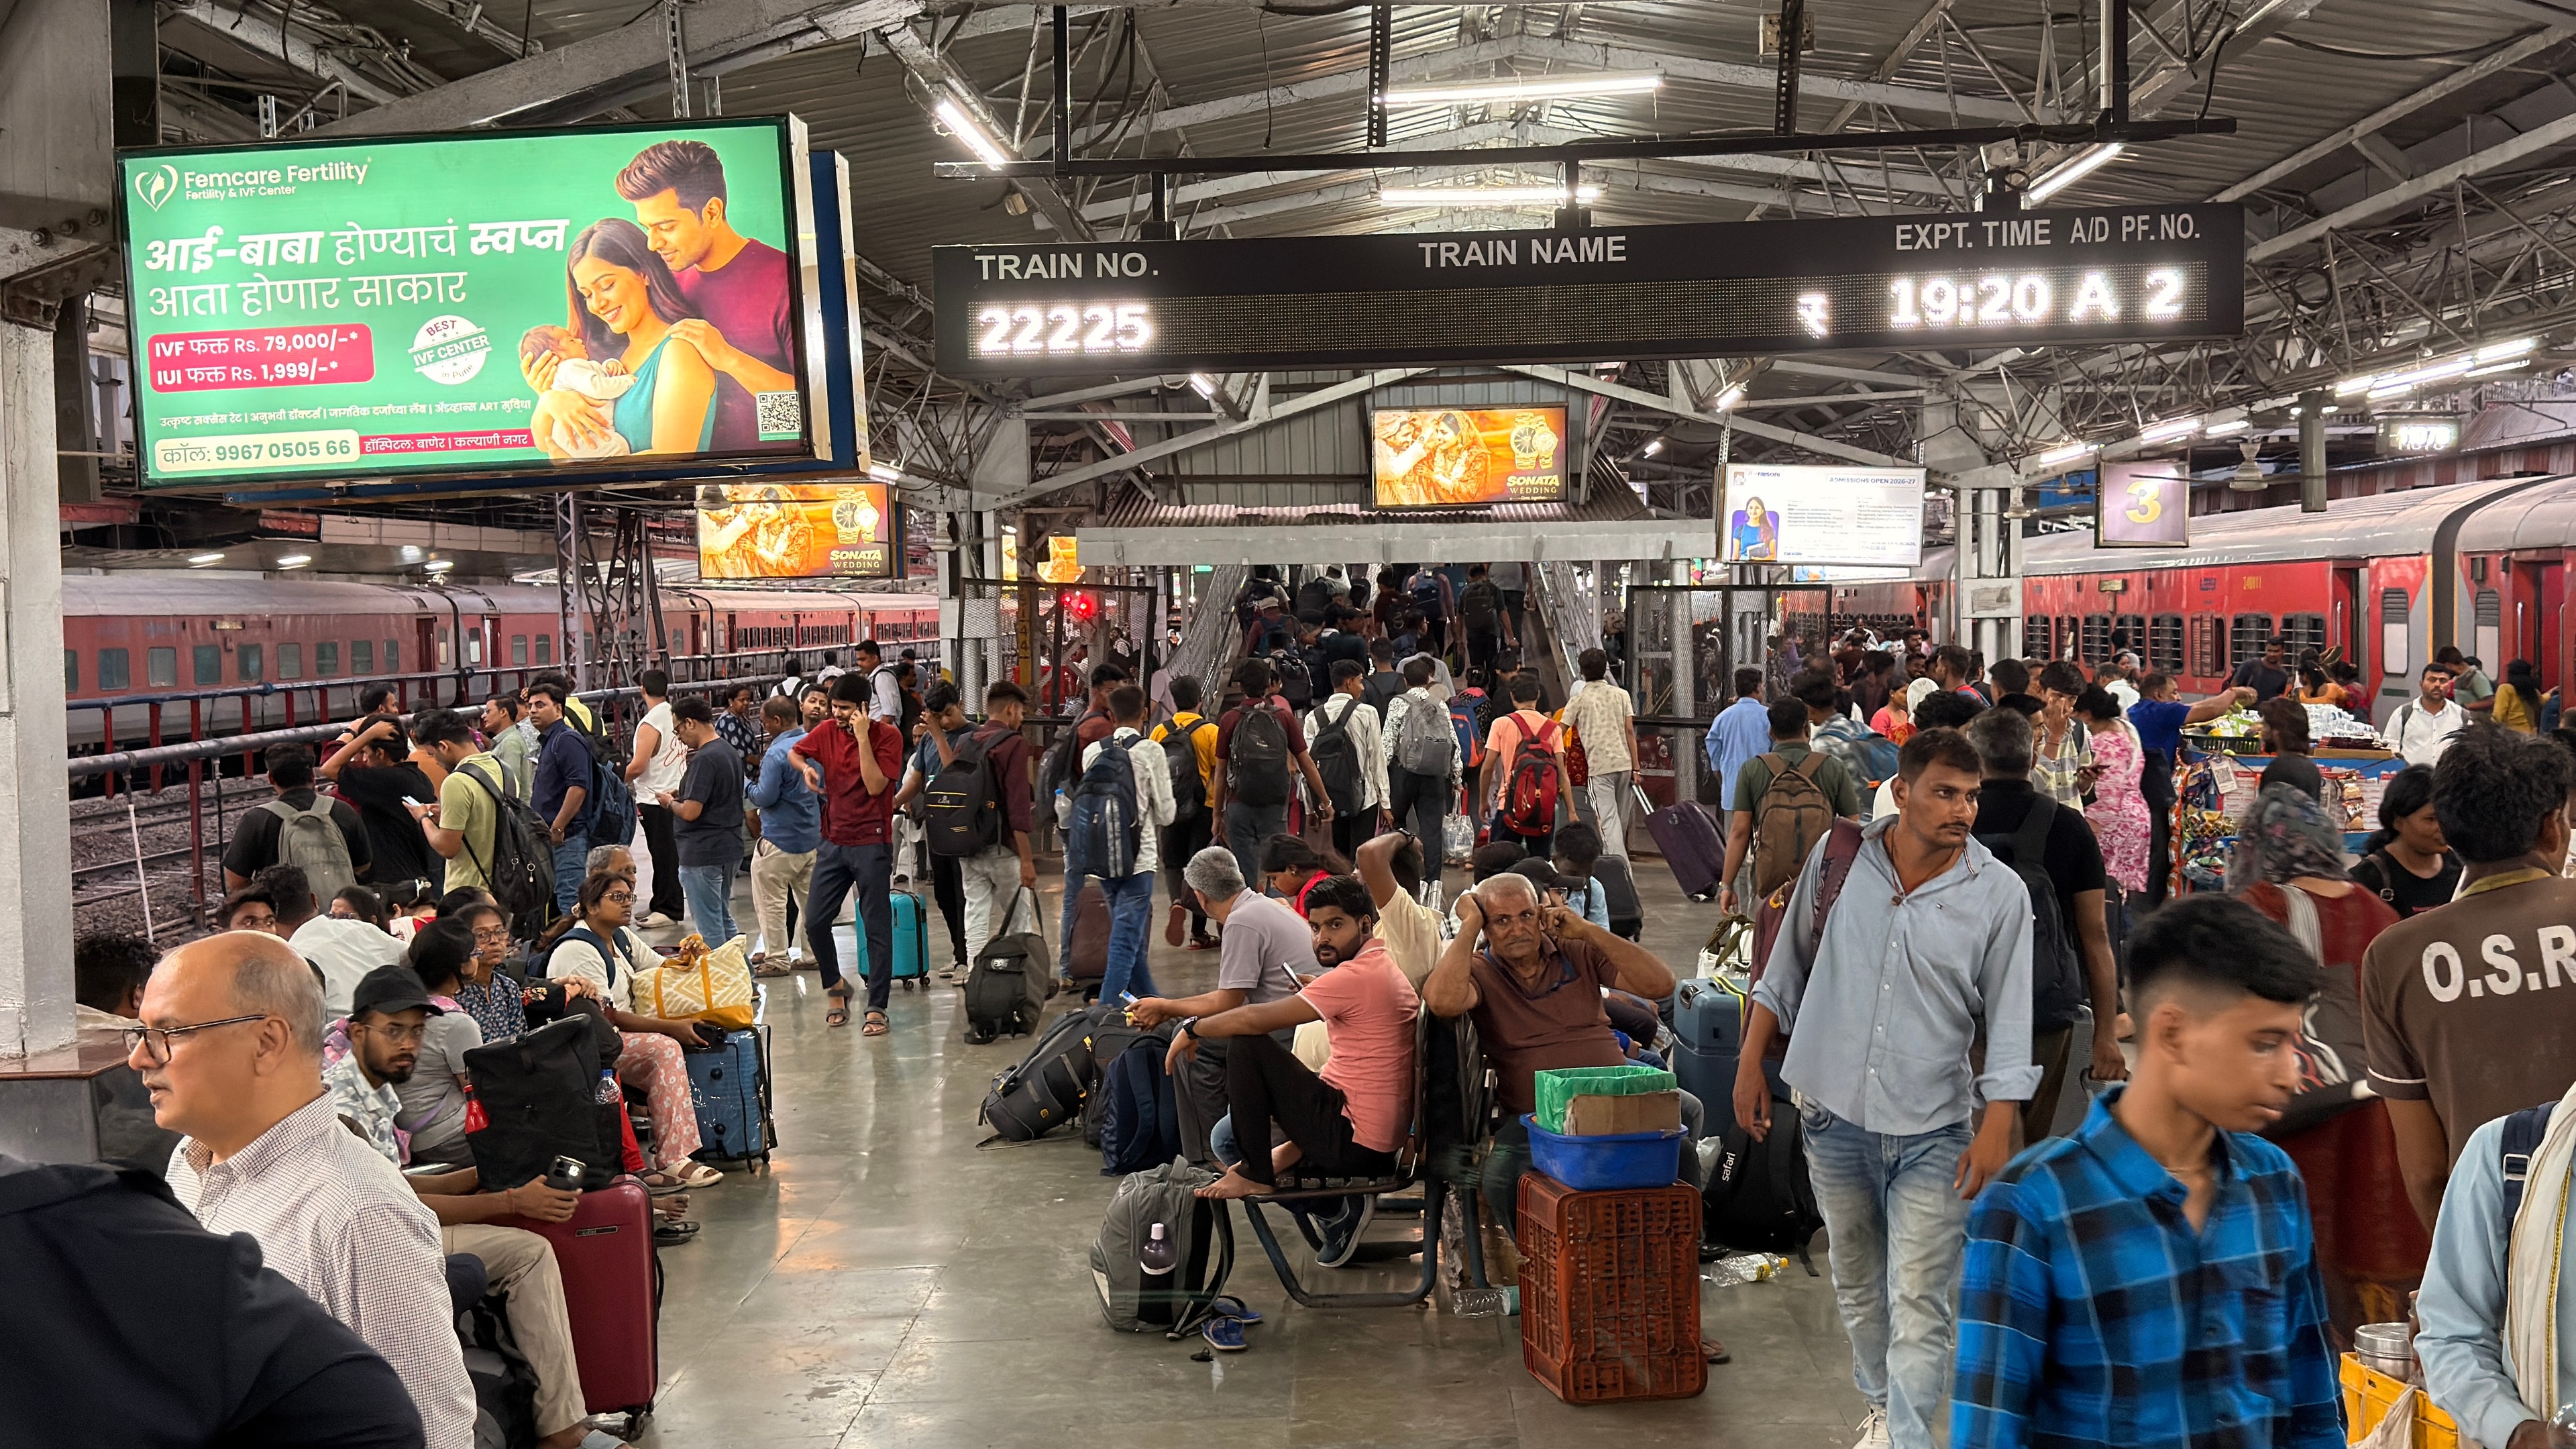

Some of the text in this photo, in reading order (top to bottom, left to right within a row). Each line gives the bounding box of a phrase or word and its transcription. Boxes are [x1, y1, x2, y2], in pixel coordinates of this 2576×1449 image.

[184, 162, 368, 189] Femcare Fertility
[186, 184, 297, 201] Fertility & IVF Center
[145, 217, 570, 274] आई-बाबा होण्याचं स्वप्न
[1895, 222, 1973, 251] EXPT.
[1982, 219, 2051, 248] TIME
[2070, 216, 2110, 244] A/D
[974, 252, 1159, 280] TRAIN NO.
[1418, 235, 1627, 268] TRAIN NAME
[150, 272, 468, 318] आता होणार साकार
[1890, 270, 2180, 329] 19:20 A 2
[426, 320, 457, 336] BEST
[979, 305, 1151, 356] 22225
[155, 341, 185, 358] IVF
[189, 338, 230, 356] फक्त
[235, 337, 260, 354] Rs.
[413, 335, 490, 366] IVF CENTER
[157, 370, 182, 386] IUI
[185, 366, 227, 383] फक्त
[232, 366, 257, 381] Rs.
[160, 416, 192, 429] उत्कृष्ट
[193, 412, 227, 425] सक्सेस
[229, 412, 242, 423] रेट
[250, 409, 286, 424] अनुभवी
[288, 407, 322, 420] डॉक्टर्स
[328, 405, 370, 417] जागतिक
[479, 402, 499, 411] ART
[500, 398, 531, 413] सुविधा
[161, 439, 351, 464] कॉल: 9967 0505 66
[364, 437, 414, 453] हॉस्पिटल:
[416, 435, 445, 449] बाणेर
[454, 433, 500, 447] कल्याणी
[502, 434, 528, 445] नगर
[1507, 475, 1560, 487] SONATA
[2126, 481, 2162, 523] 3
[830, 549, 882, 561] SONATA
[1722, 1151, 1736, 1181] safari
